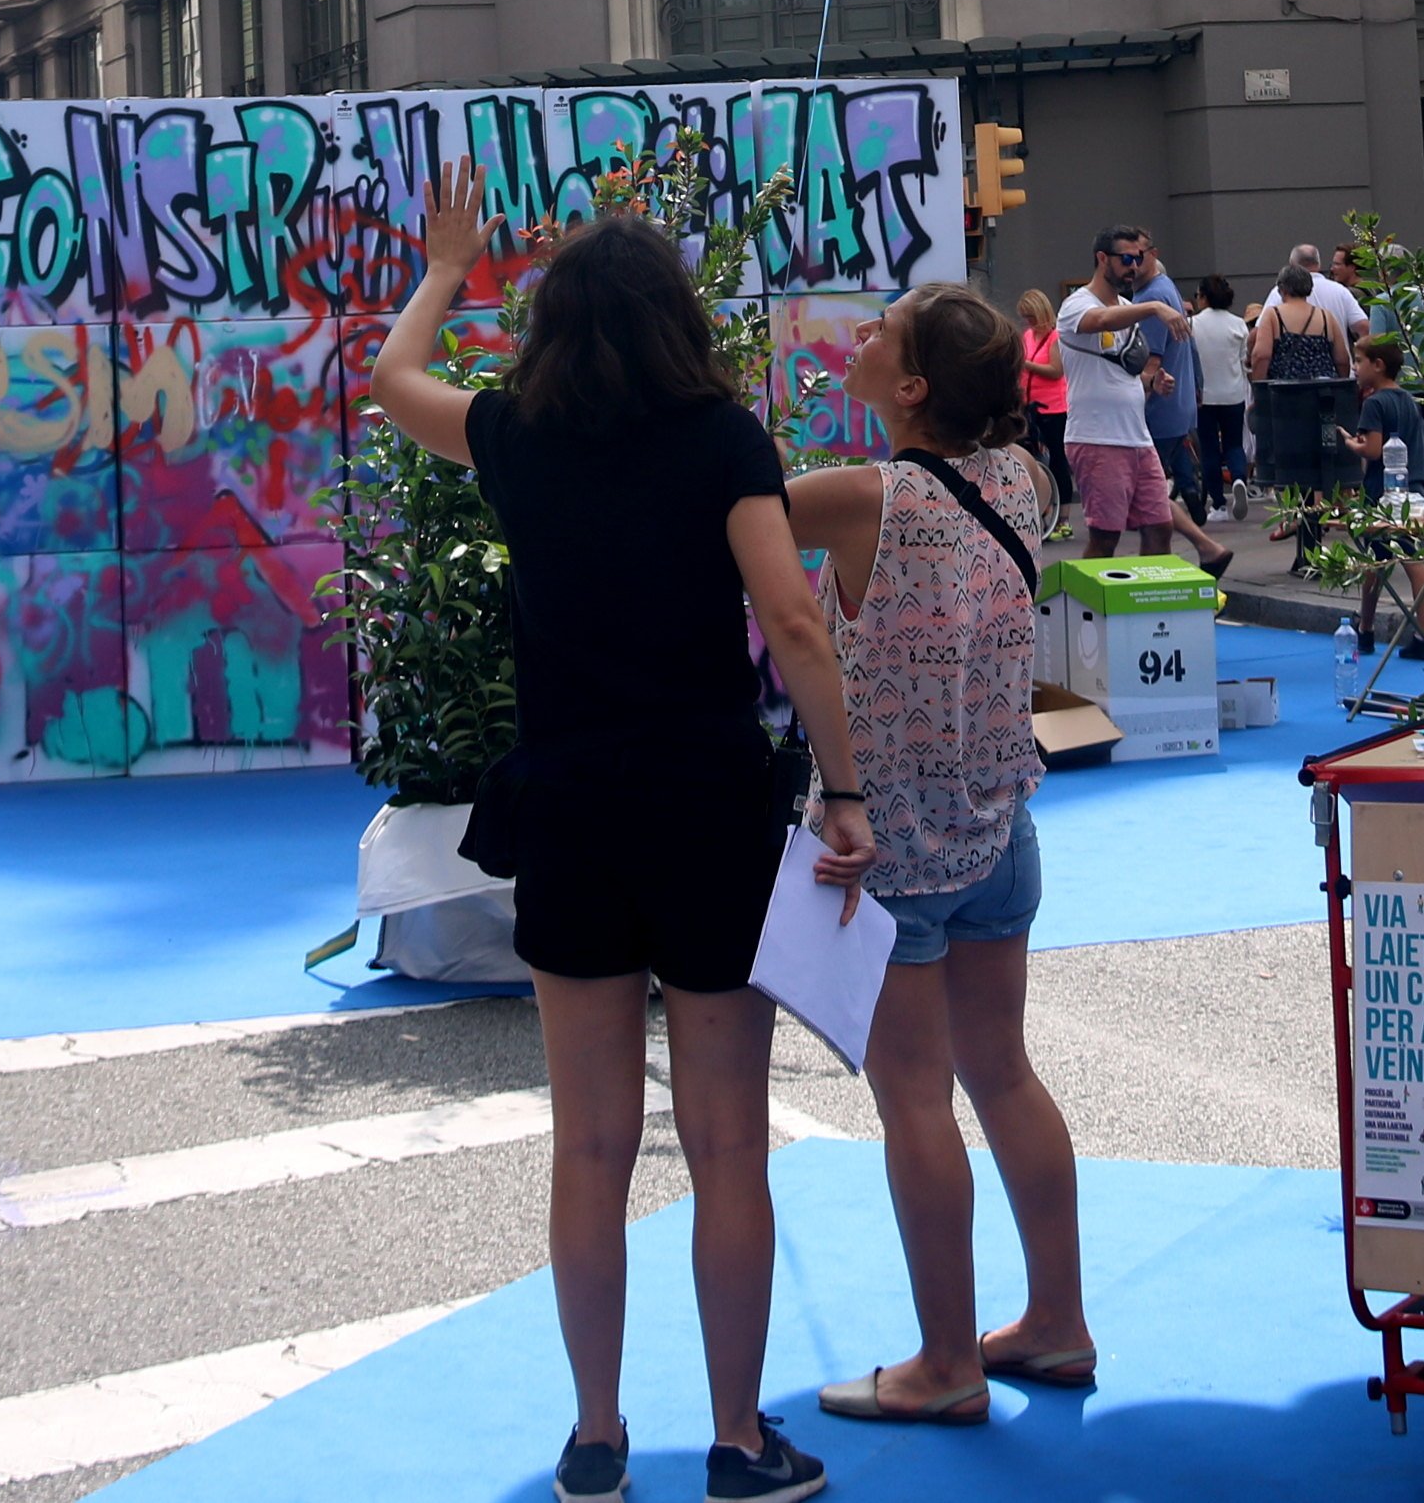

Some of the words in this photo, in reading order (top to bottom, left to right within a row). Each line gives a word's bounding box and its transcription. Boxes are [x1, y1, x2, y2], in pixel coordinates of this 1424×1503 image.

[1138, 649, 1186, 685] 94
[1364, 894, 1407, 929] VIA
[1365, 970, 1399, 1004] UN
[1366, 1007, 1414, 1044] PER
